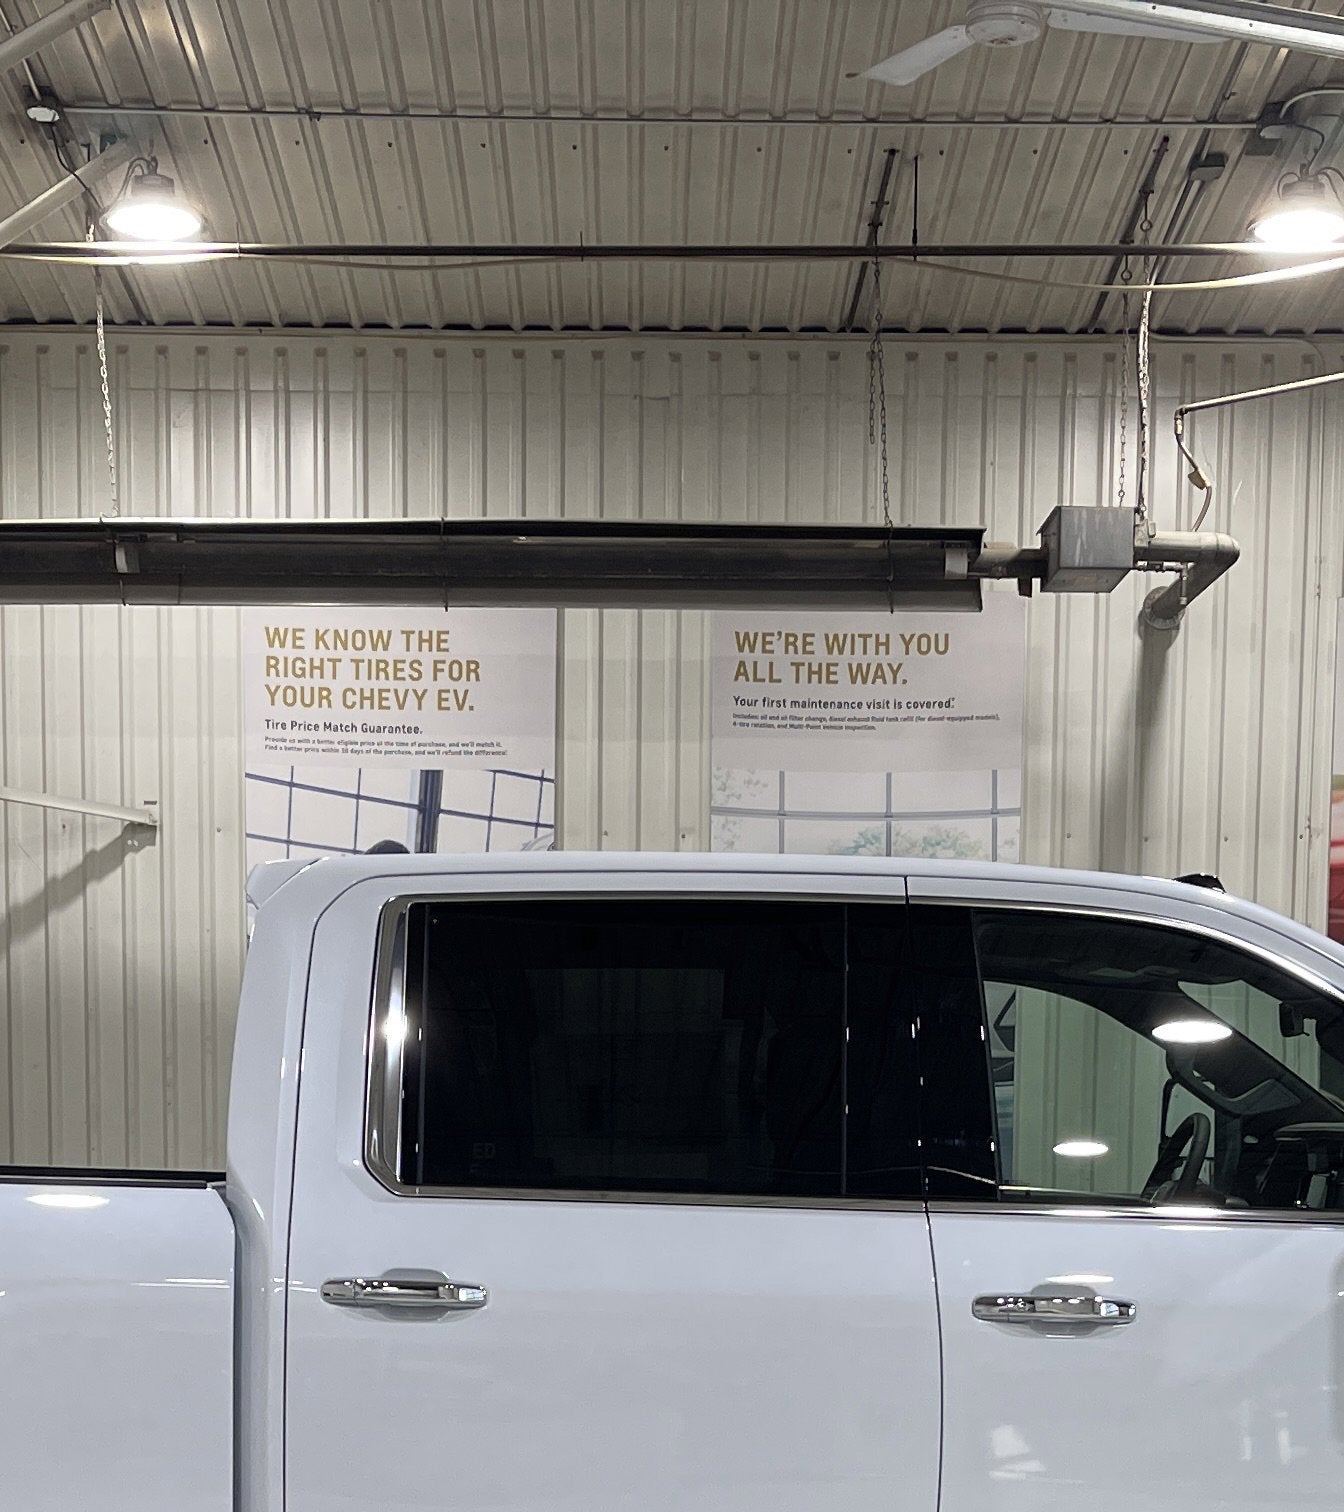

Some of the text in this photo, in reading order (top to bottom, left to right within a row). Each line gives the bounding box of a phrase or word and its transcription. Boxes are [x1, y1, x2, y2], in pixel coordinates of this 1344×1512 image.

[264, 626, 450, 652] WE KNOW THE
[734, 631, 950, 655] WE'RE WITH YOU
[264, 656, 480, 682] RIGHT TIRES FOR
[733, 661, 907, 685] ALL THE WAY.
[264, 684, 474, 711] YOUR CHEVY EV.
[733, 696, 758, 707] Your
[762, 697, 787, 708] first
[790, 698, 863, 709] maintenance
[866, 699, 890, 709] visit
[894, 699, 902, 709] is
[264, 719, 423, 734] Tire Price Match Guarantee.
